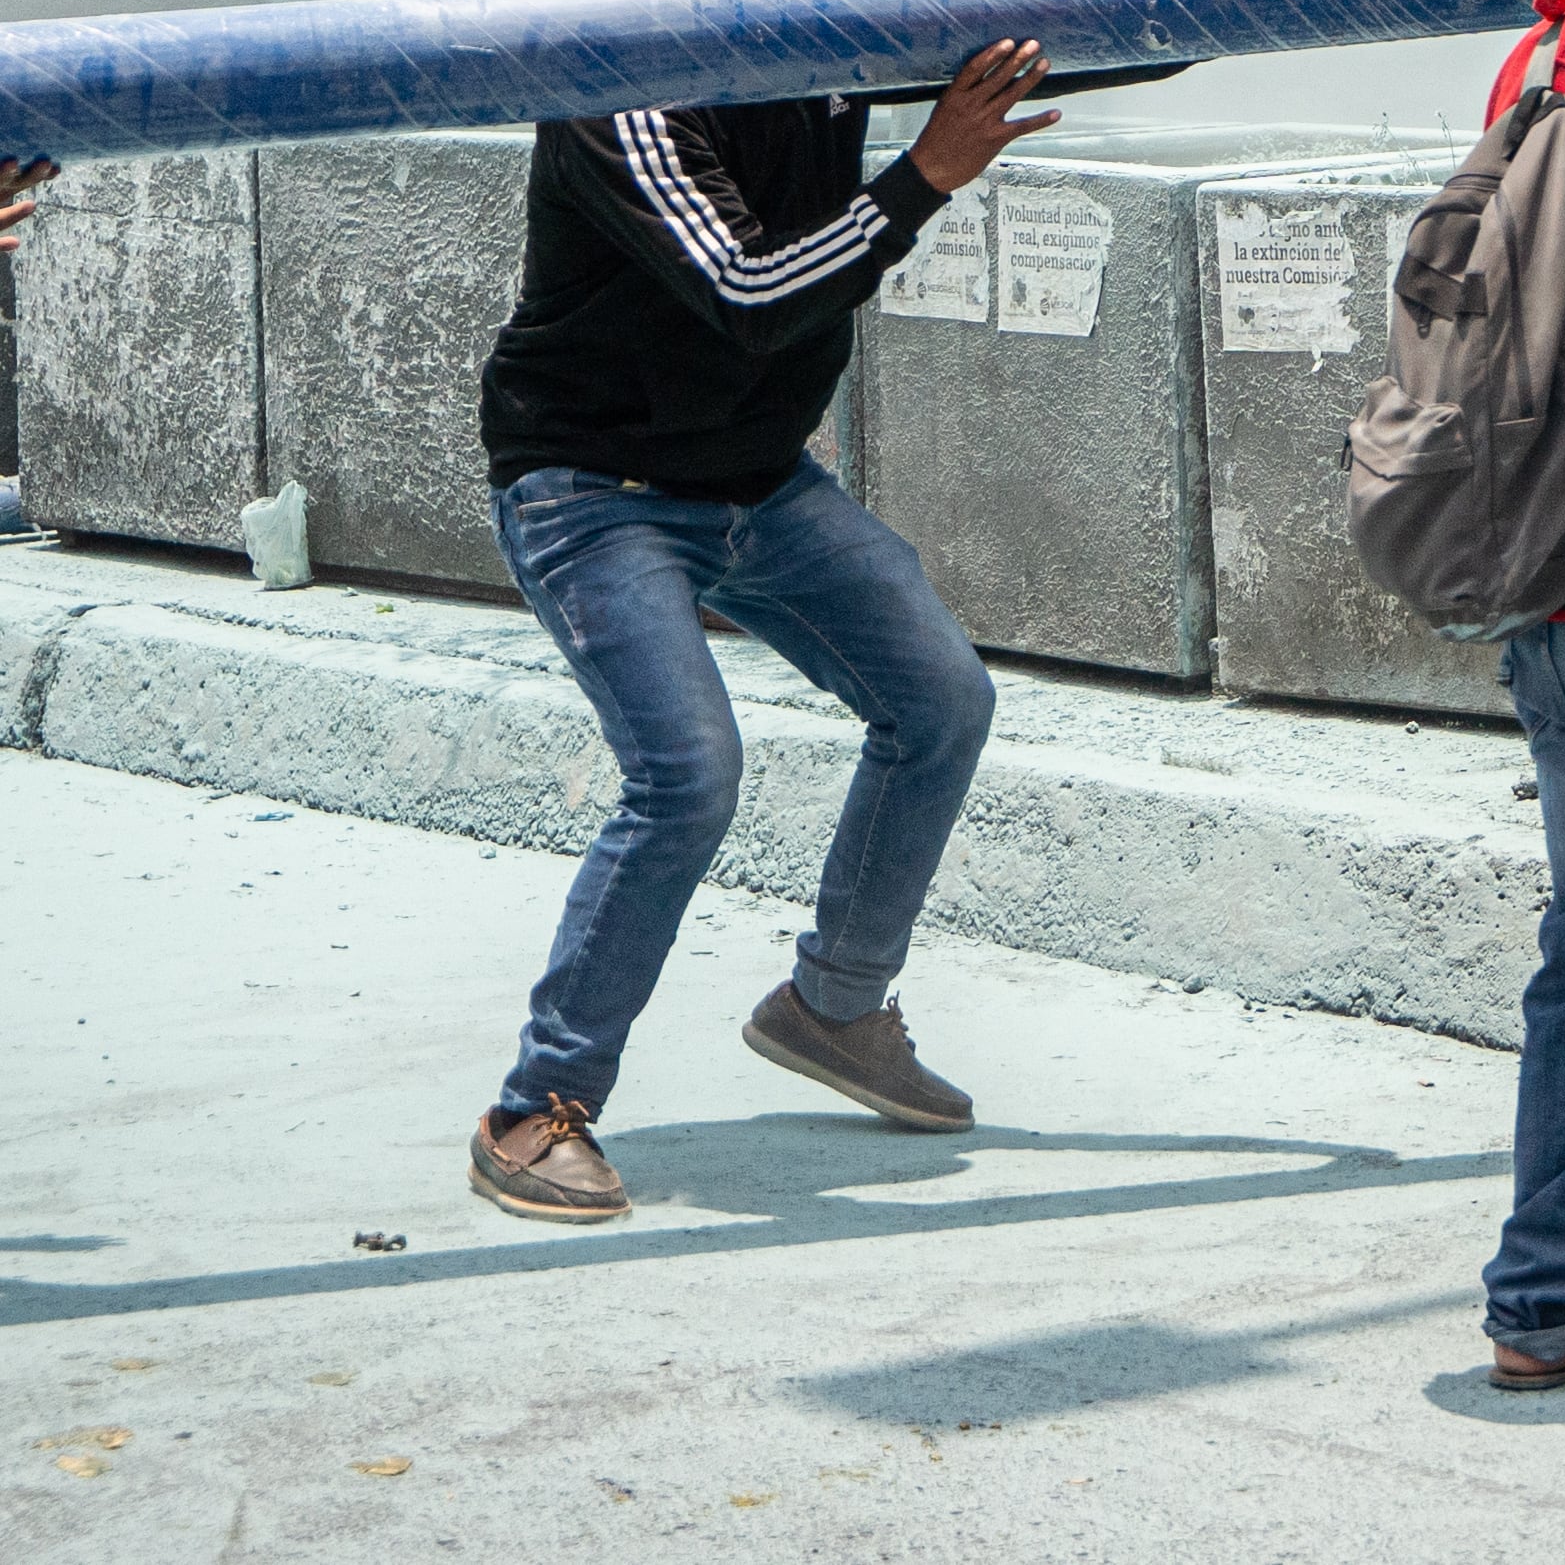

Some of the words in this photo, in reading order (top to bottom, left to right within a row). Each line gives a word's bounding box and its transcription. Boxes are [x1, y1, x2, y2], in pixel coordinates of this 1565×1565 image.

[1002, 204, 1061, 225] ¡Voluntad
[961, 217, 976, 235] de
[1012, 228, 1039, 248] real,
[1233, 242, 1248, 260] la
[1251, 242, 1321, 262] extinción
[1324, 242, 1341, 261] de
[1225, 266, 1280, 284] nuestra
